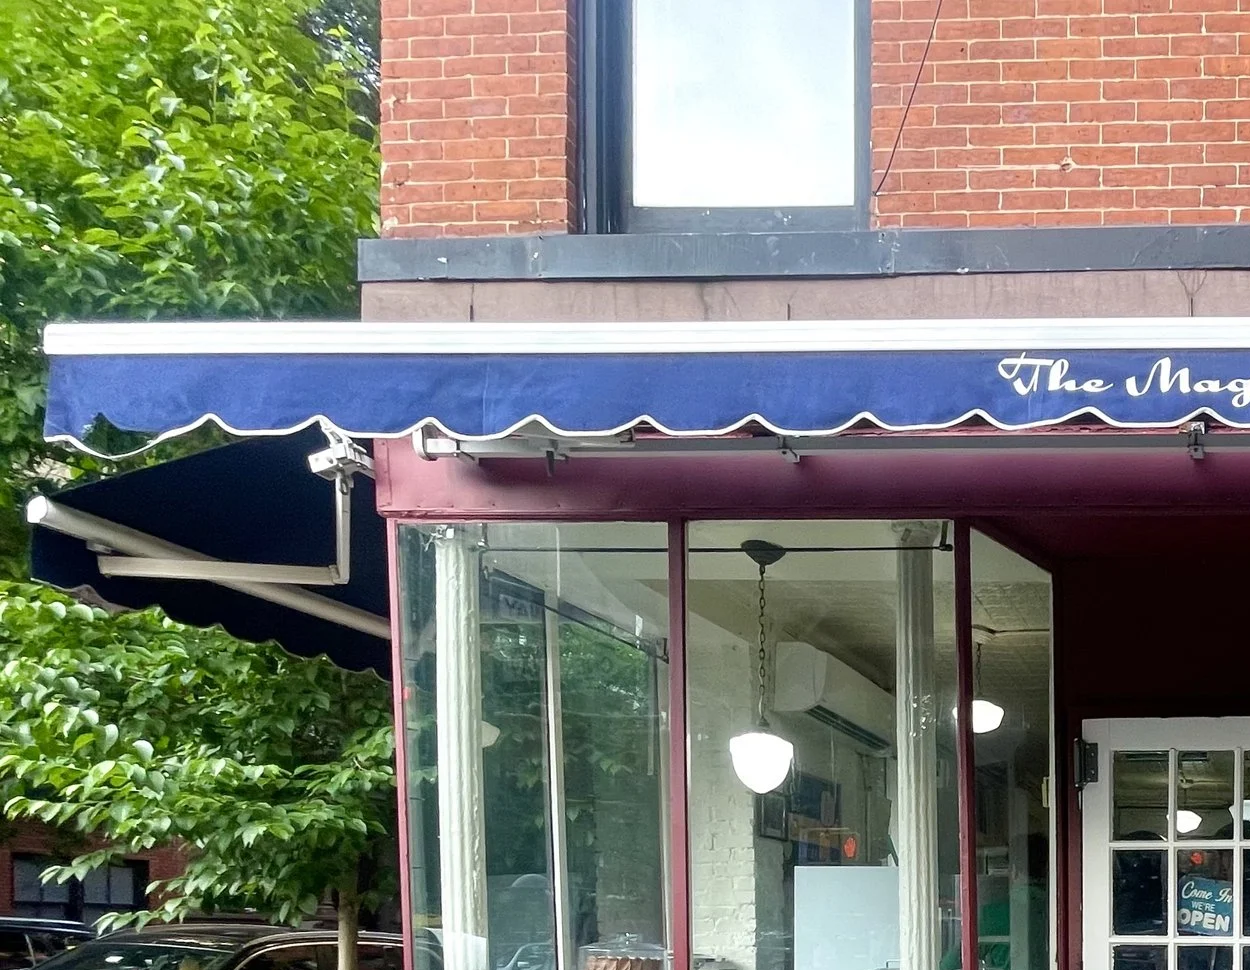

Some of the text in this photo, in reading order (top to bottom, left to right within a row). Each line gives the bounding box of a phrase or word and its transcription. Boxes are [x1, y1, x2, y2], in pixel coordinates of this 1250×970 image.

[998, 352, 1113, 396] The
[1181, 880, 1233, 904] Come In
[1177, 908, 1230, 932] OPEN
